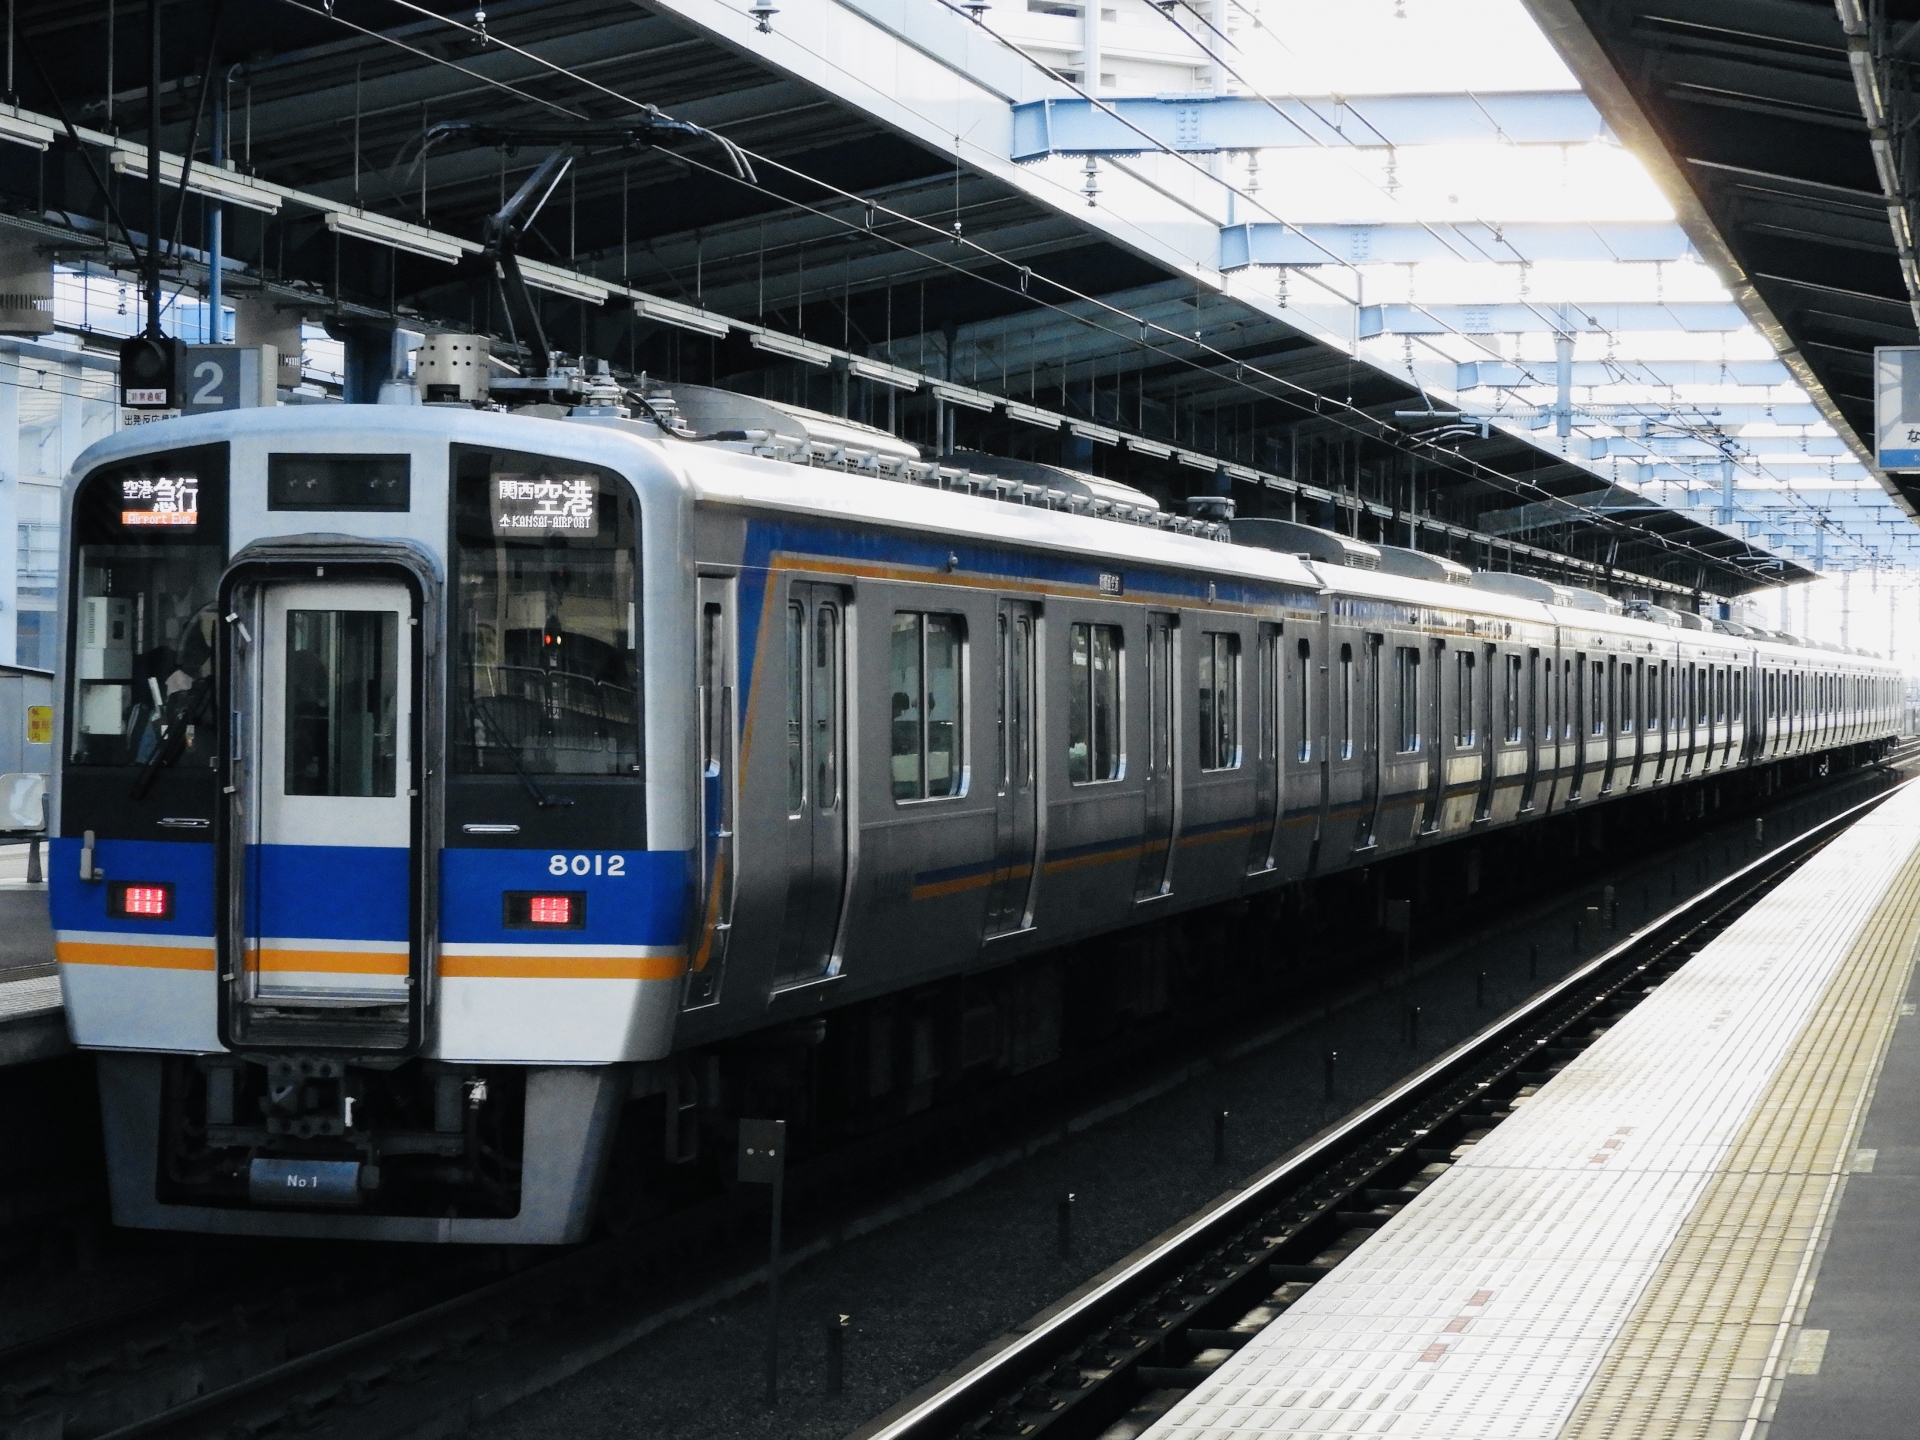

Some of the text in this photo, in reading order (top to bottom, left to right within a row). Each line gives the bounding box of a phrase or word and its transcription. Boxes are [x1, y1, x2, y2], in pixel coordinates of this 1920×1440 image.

[193, 361, 223, 404] 2
[124, 414, 178, 426] 出発反応
[499, 480, 593, 517] 関西空港
[127, 513, 167, 525] Airport
[511, 515, 591, 529] KANSAI-AIRPORT
[548, 854, 626, 876] 8012
